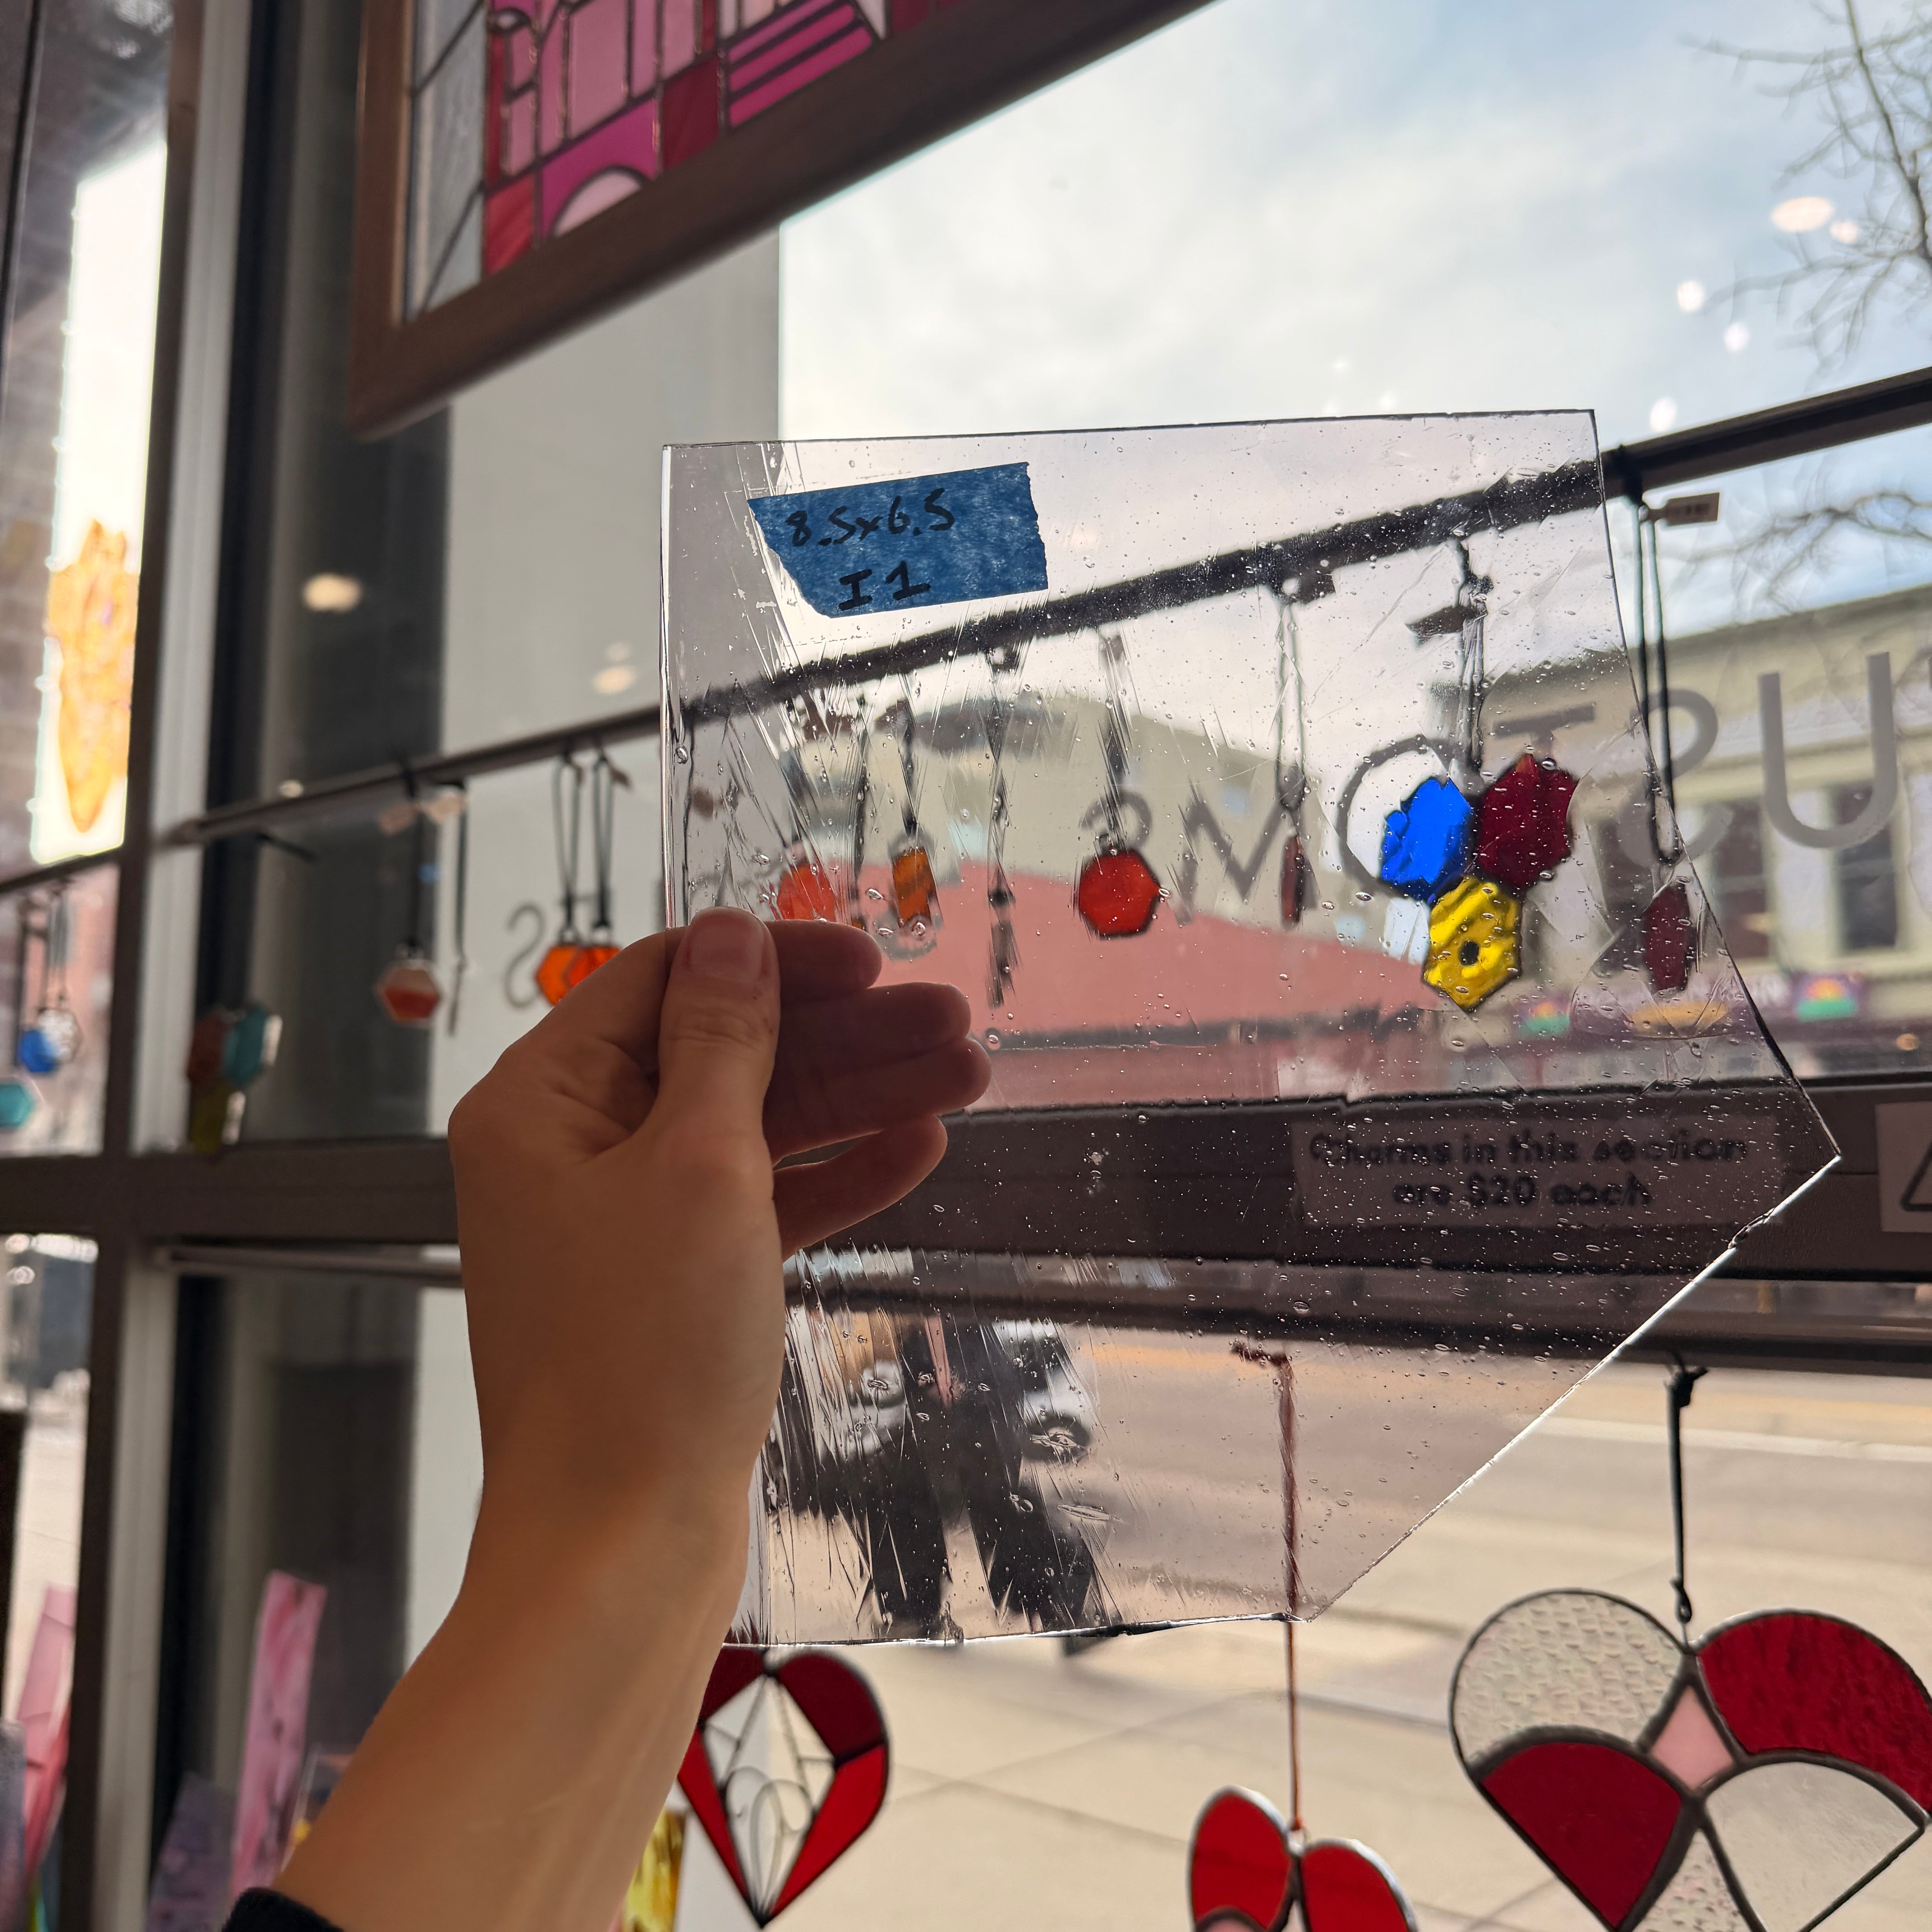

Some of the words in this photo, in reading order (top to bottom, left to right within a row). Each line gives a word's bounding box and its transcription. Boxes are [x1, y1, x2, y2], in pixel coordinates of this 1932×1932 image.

[1310, 1131, 1451, 1165] Charms
[1461, 1132, 1495, 1163] in
[1508, 1127, 1579, 1163] this
[1593, 1128, 1747, 1163] section
[1392, 1183, 1452, 1205] are
[1466, 1172, 1537, 1207] $20
[1550, 1172, 1651, 1207] each
